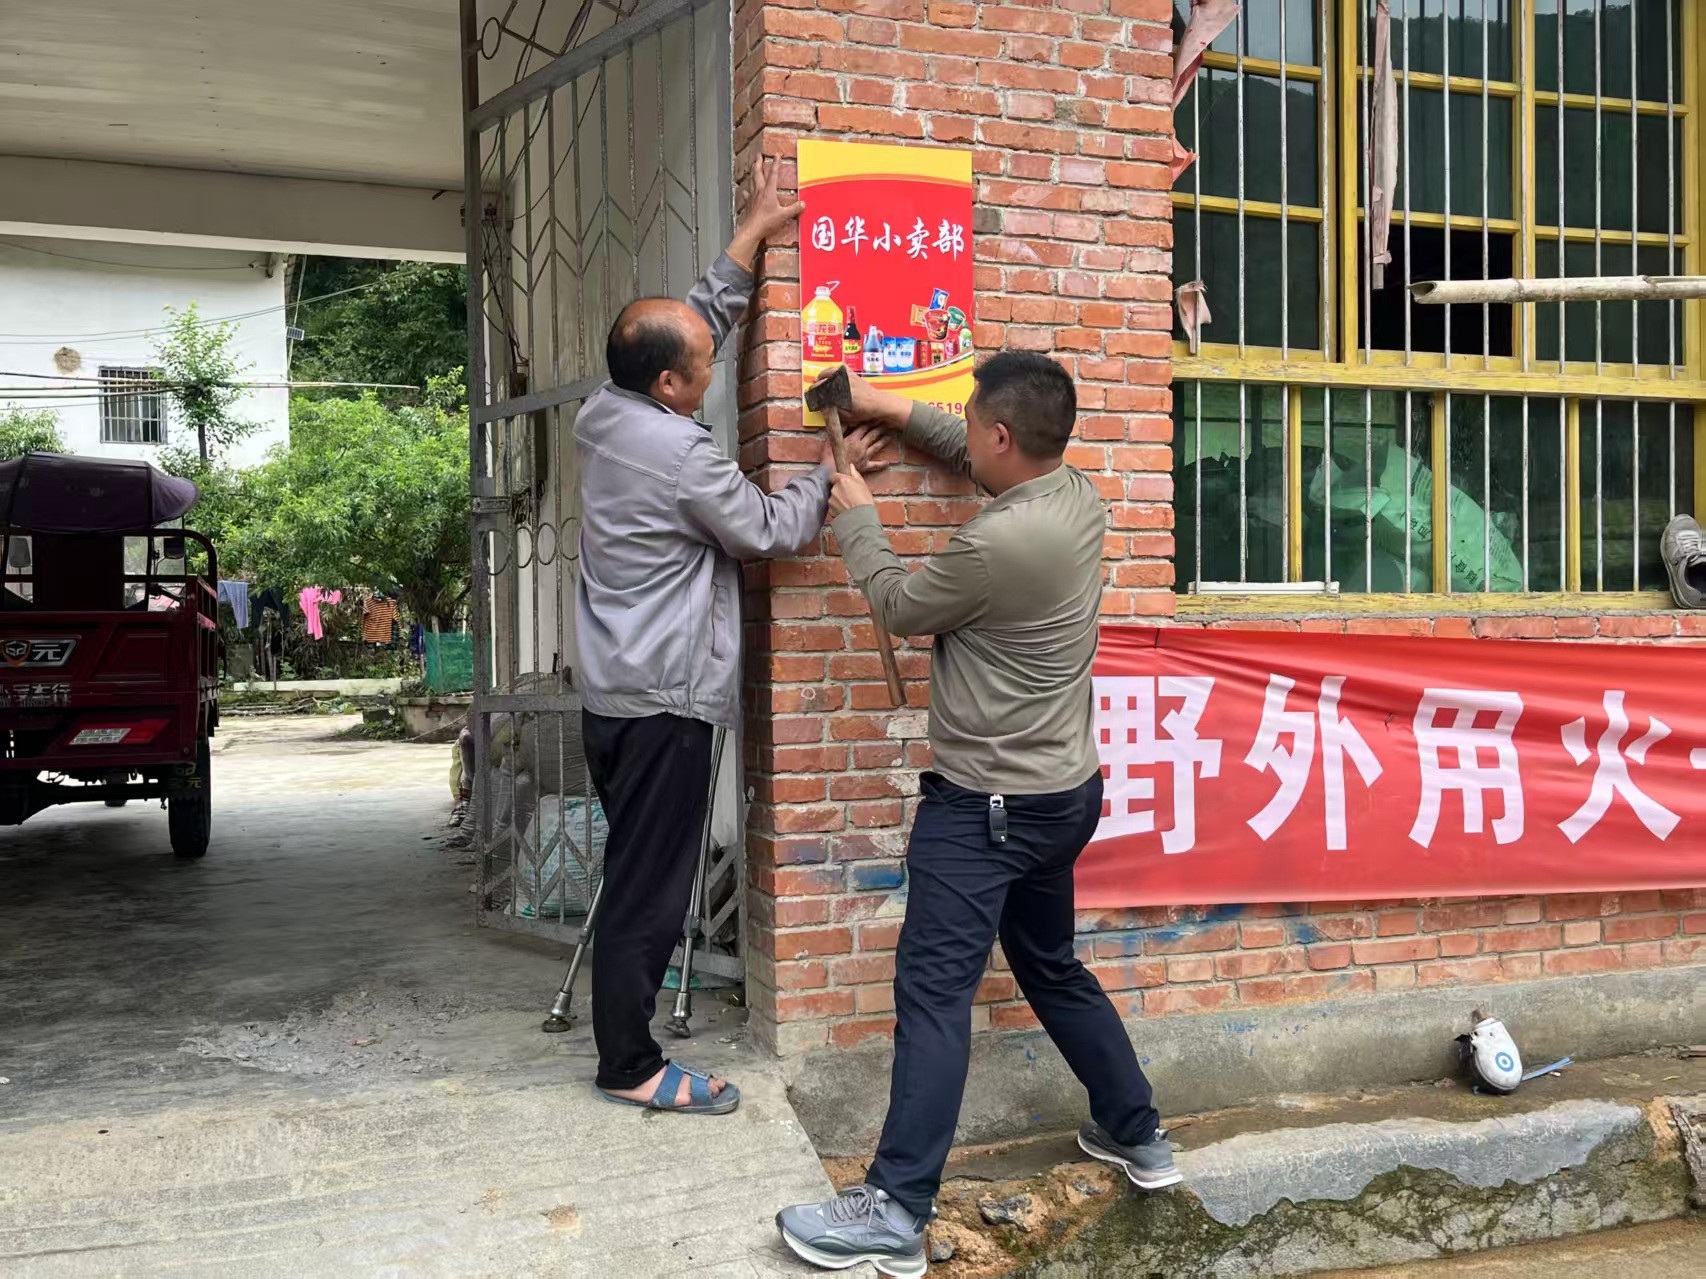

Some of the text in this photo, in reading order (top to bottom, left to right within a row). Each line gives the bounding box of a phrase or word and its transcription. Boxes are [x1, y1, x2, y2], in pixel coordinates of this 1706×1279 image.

[811, 215, 966, 262] 国华小卖部
[31, 644, 61, 661] 元
[1089, 672, 1706, 855] 野外用火
